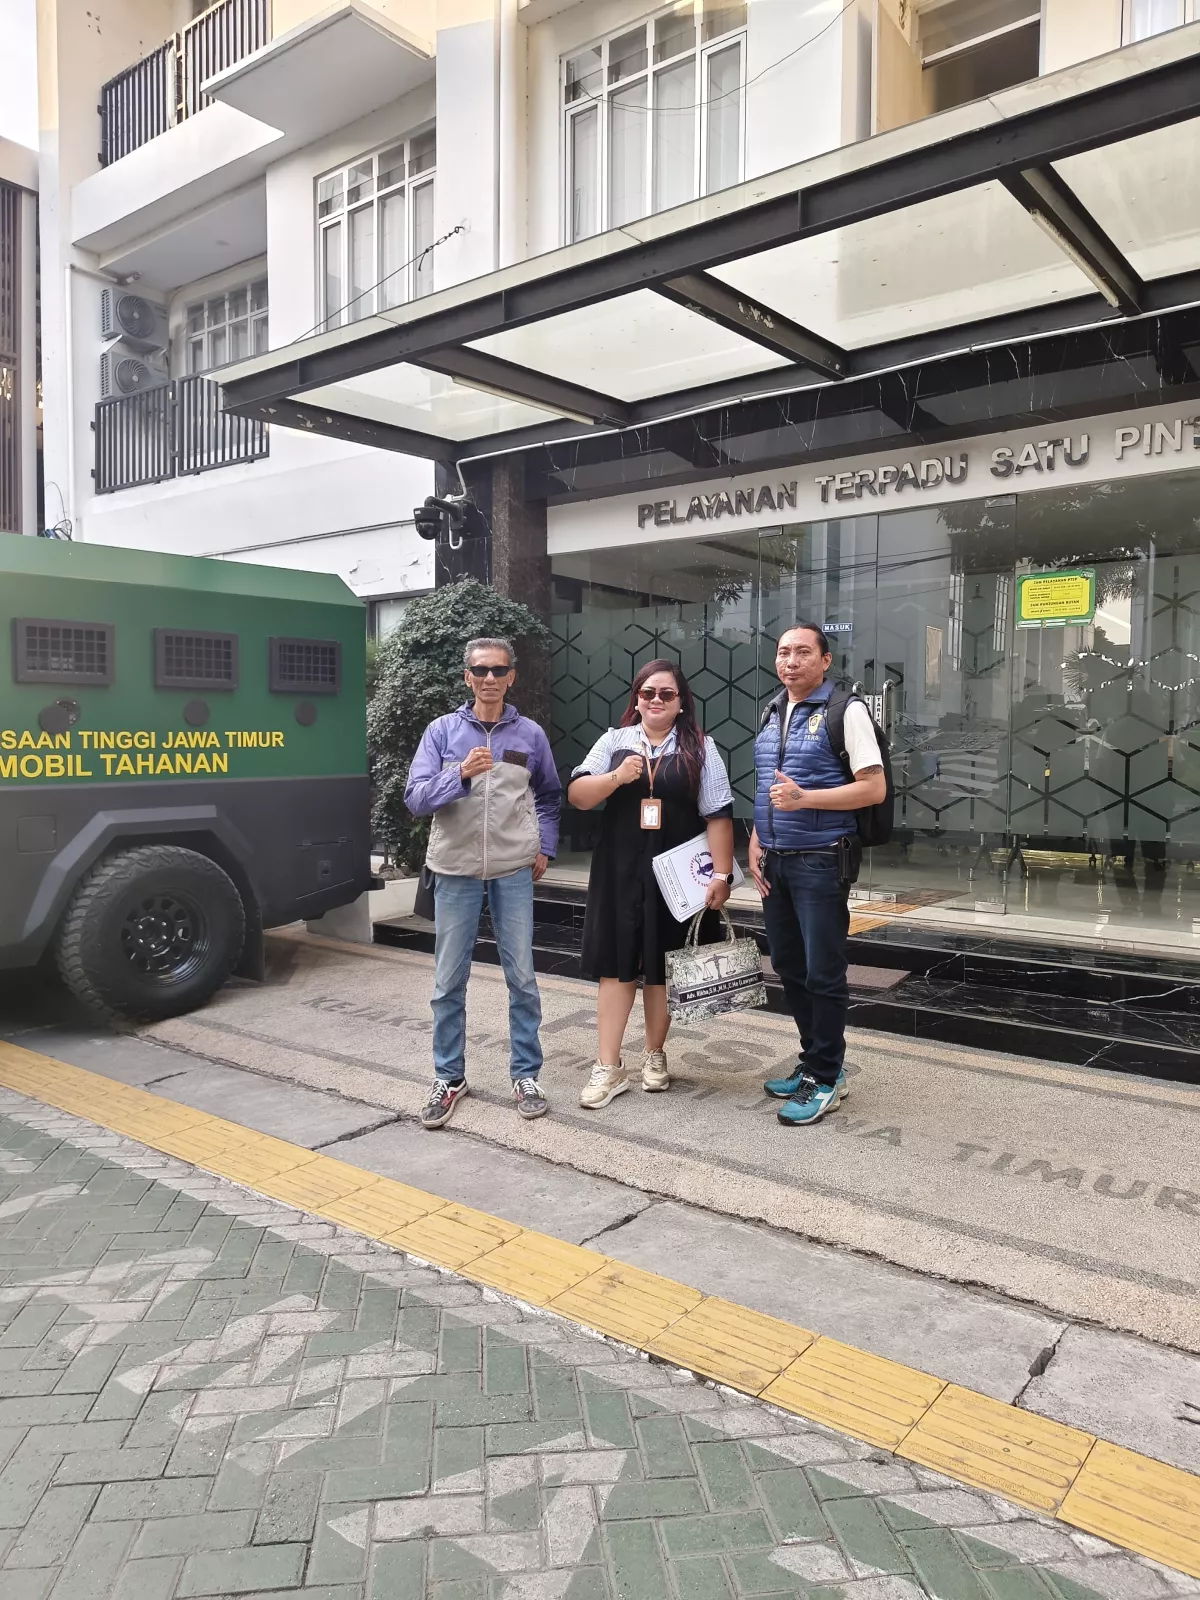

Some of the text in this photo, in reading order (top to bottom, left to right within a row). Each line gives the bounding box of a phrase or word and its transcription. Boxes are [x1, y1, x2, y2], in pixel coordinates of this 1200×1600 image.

[637, 481, 797, 528] PELAYANAN
[815, 453, 968, 503] TERPADU
[990, 434, 1090, 477] SATU
[78, 731, 156, 749] TINGGI
[162, 731, 221, 749] JAWA
[224, 731, 285, 748] TIMUR
[0, 753, 228, 778] MOBIL TAHANAN
